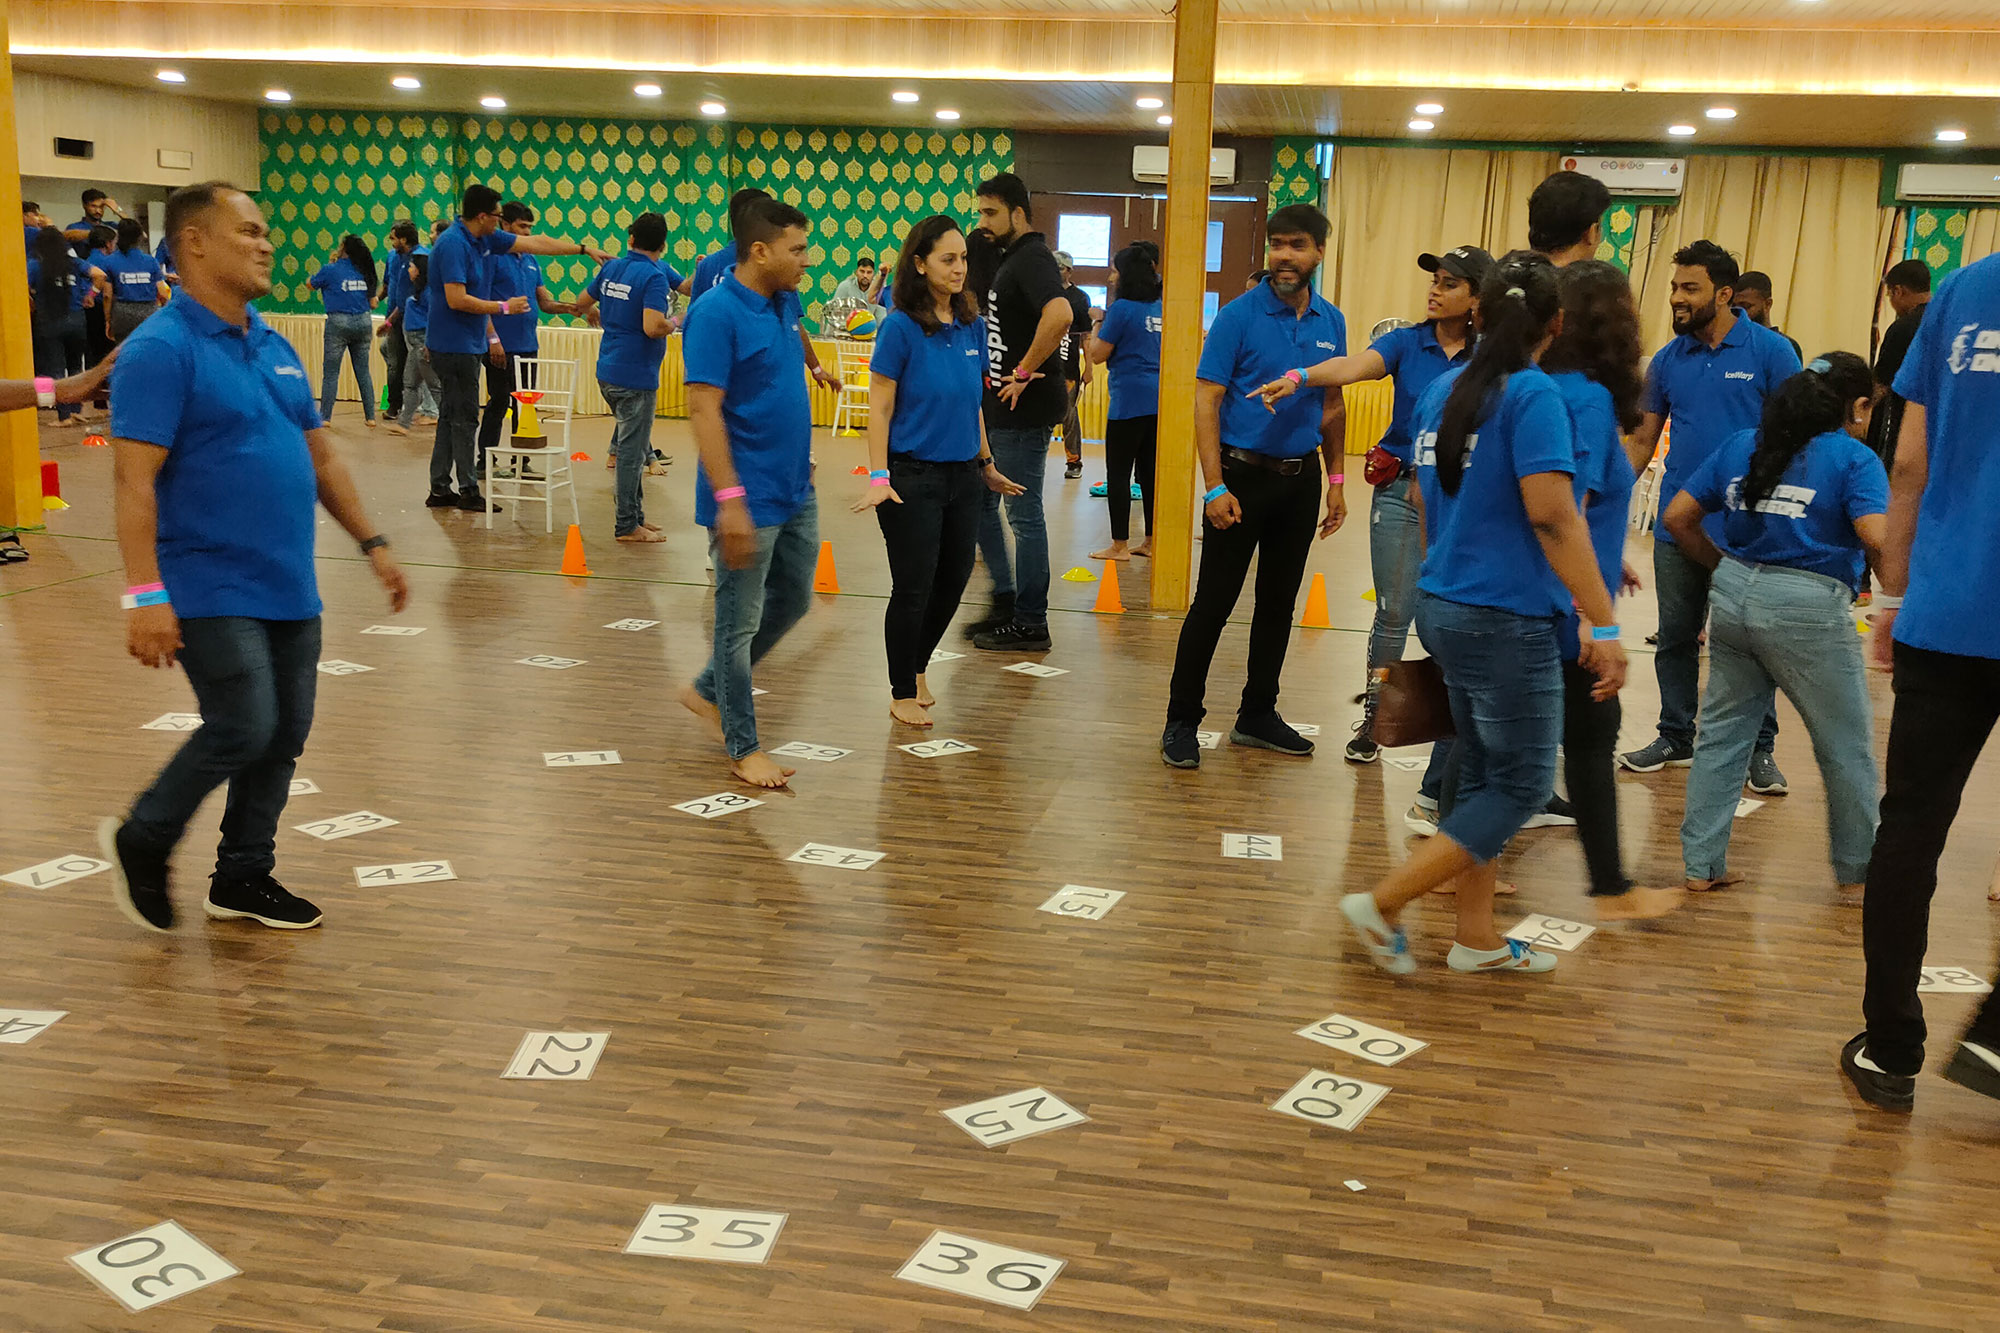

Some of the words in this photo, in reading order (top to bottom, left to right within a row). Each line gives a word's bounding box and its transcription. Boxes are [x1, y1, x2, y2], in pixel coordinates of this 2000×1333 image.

[528, 656, 578, 667] 02
[547, 752, 608, 764] 41
[780, 743, 846, 758] 29
[908, 739, 968, 755] 04
[684, 795, 751, 815] 28
[305, 814, 383, 836] 23
[798, 848, 875, 865] 43
[1238, 835, 1273, 858] 44
[361, 864, 449, 880] 42
[1059, 891, 1110, 915] 15
[1524, 918, 1582, 946] 34
[527, 1034, 593, 1077] 22
[1292, 1077, 1363, 1119] 03
[964, 1096, 1067, 1138] 25
[641, 1213, 772, 1249] 35
[97, 1236, 207, 1298] 30
[916, 1242, 1048, 1292] 36
